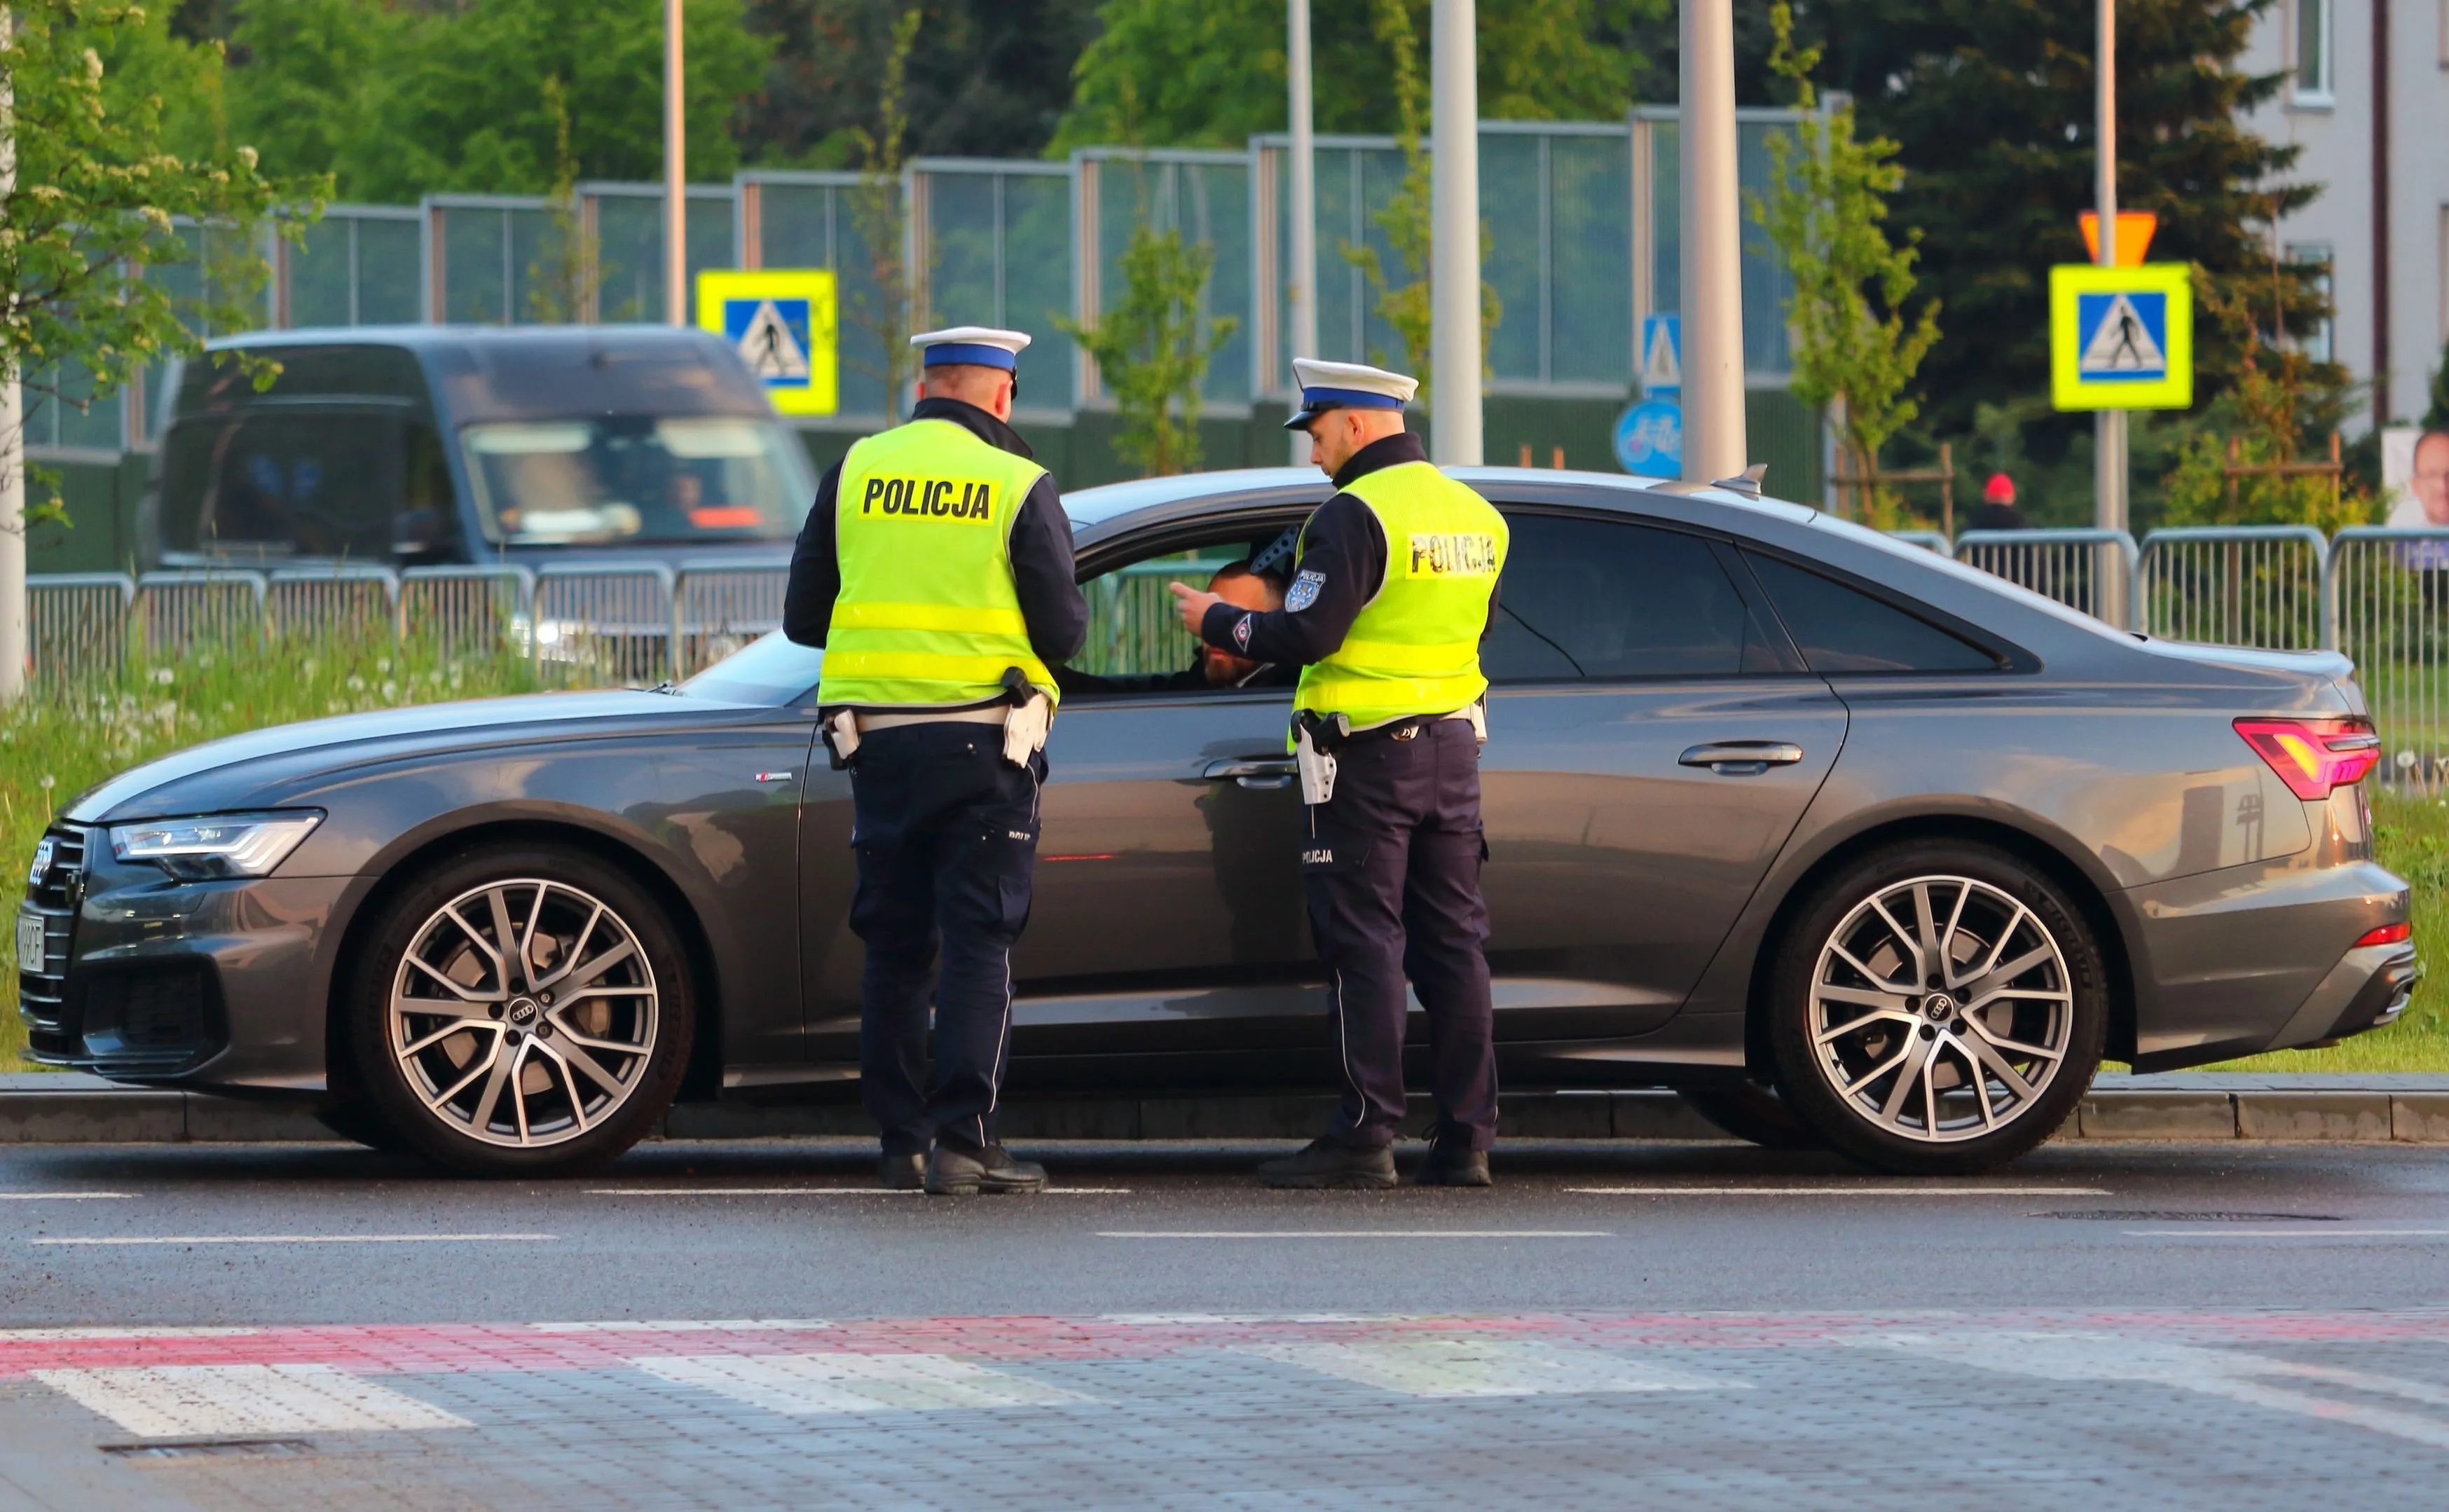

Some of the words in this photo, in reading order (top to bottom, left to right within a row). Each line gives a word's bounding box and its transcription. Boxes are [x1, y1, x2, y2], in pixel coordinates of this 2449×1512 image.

[863, 478, 990, 521] POLICJA
[1411, 535, 1496, 574] POLICJA
[1302, 849, 1333, 865] POLICJA
